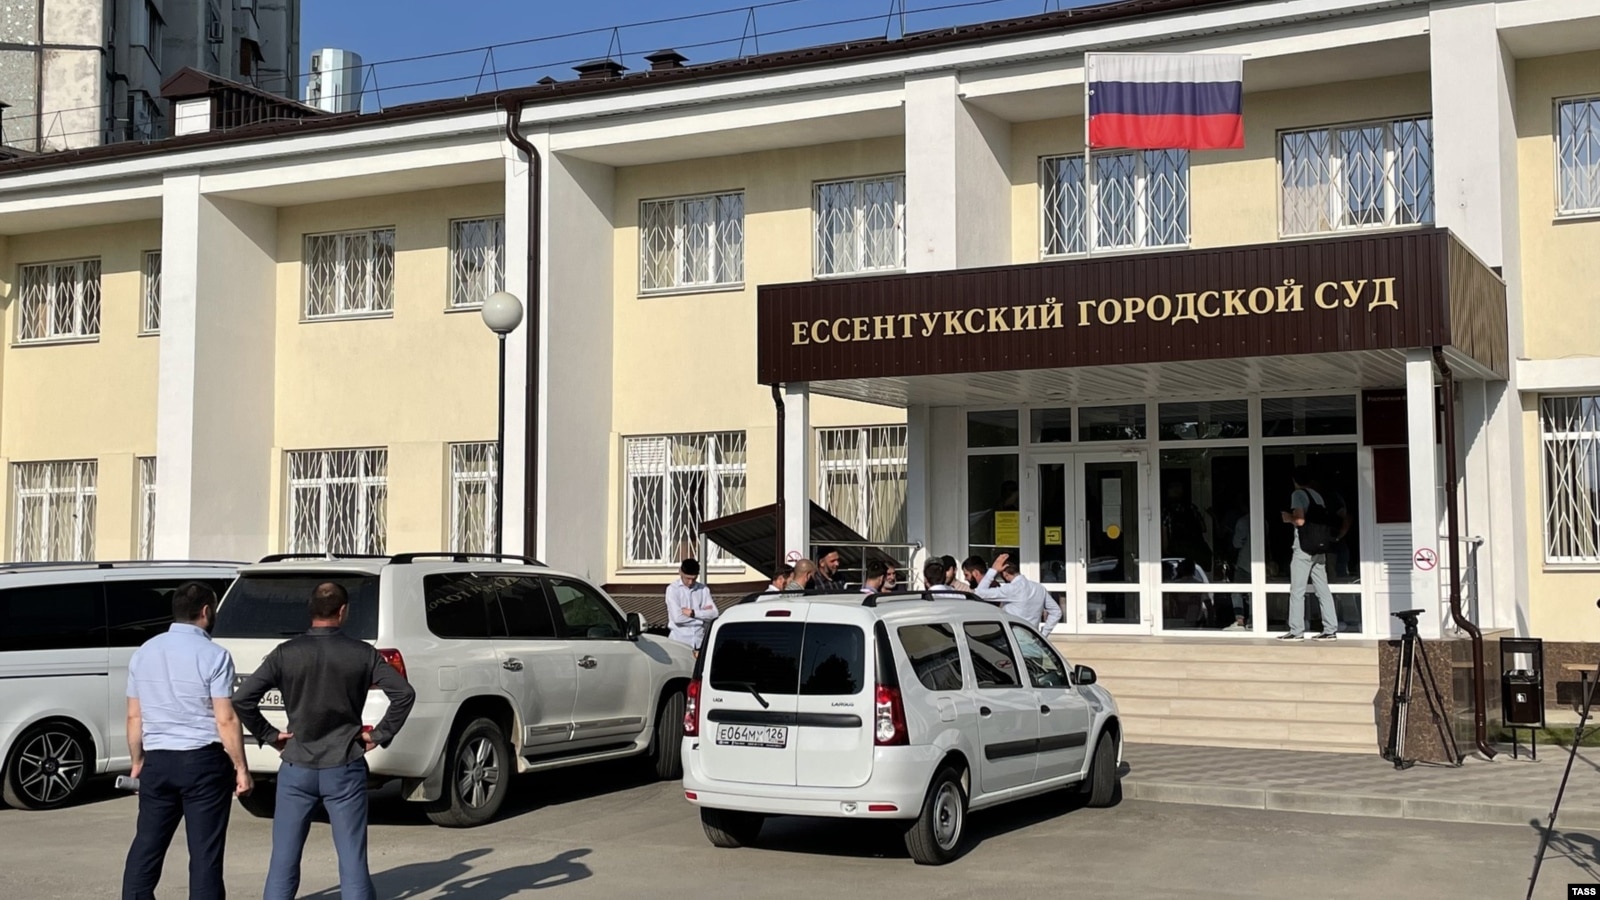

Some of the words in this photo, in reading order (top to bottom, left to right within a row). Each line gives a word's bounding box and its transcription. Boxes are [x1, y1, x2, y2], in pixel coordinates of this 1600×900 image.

[791, 297, 1064, 346] ЕССЕНТУКСКИЙ
[1077, 278, 1304, 326] ГОРОДСКОЙ
[1314, 277, 1398, 312] СУД
[766, 728, 783, 739] 126
